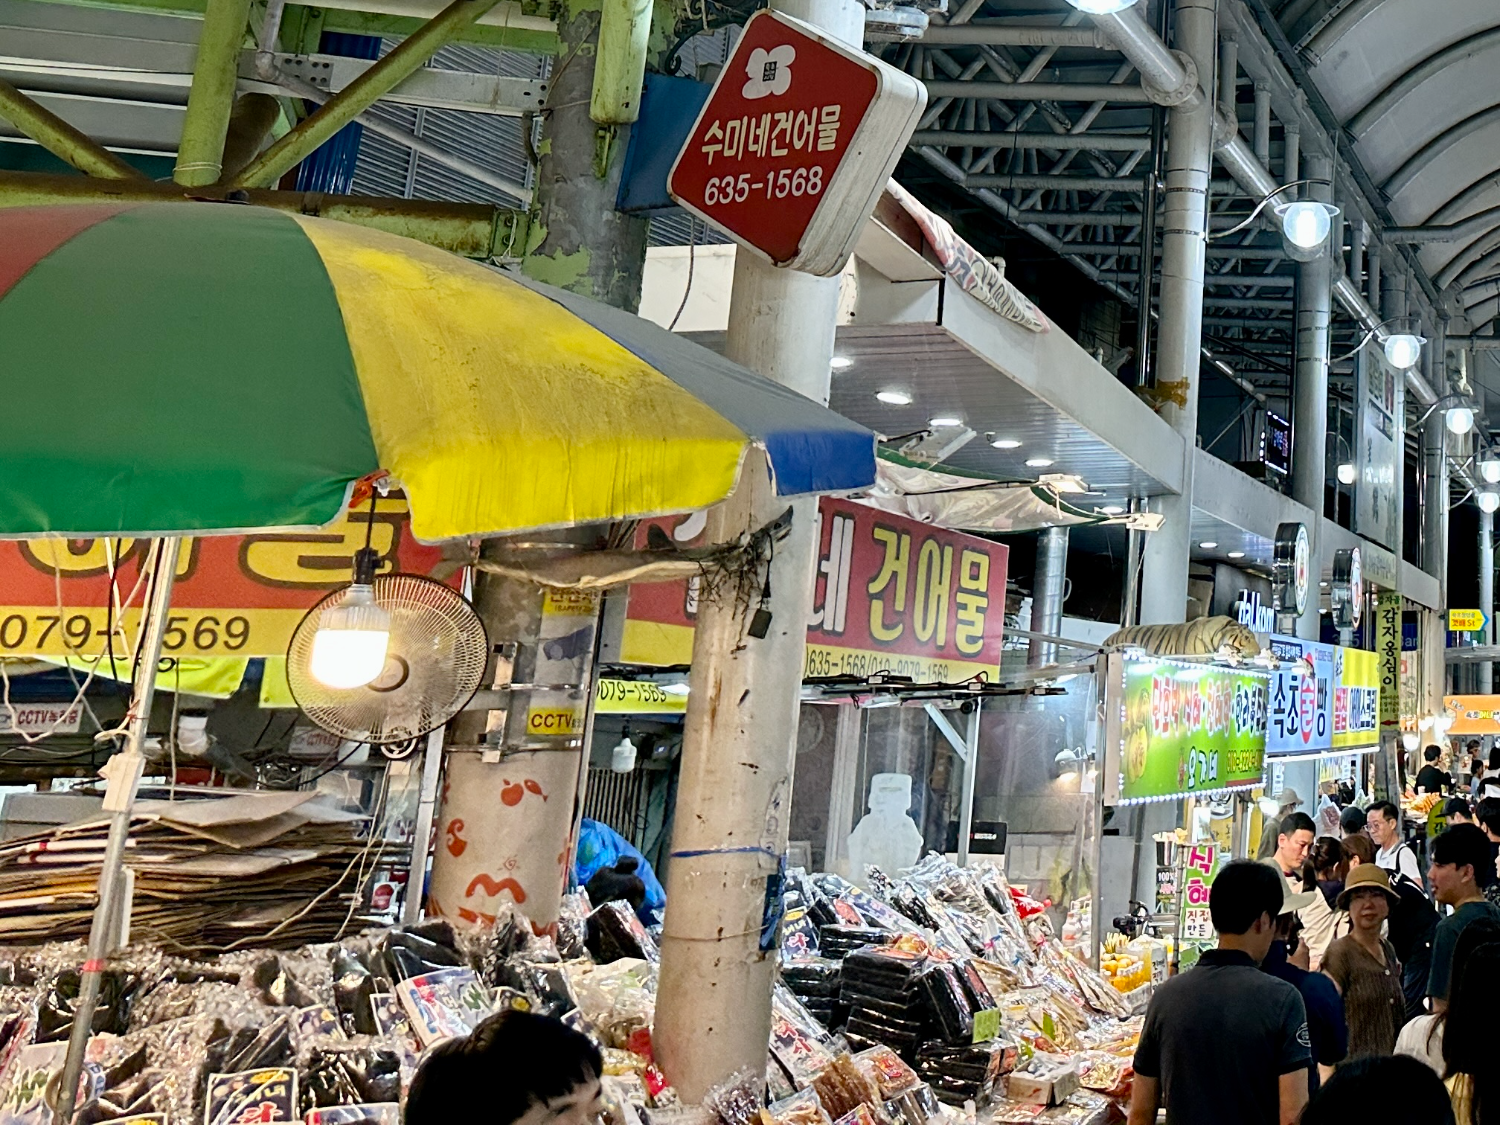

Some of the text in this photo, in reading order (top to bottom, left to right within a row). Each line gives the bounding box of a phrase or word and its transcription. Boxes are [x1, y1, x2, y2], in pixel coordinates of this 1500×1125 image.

[701, 104, 841, 165] 수미네건어물
[704, 166, 824, 206] 635-1568
[868, 526, 990, 654] 건어물
[0, 614, 251, 651] 079-569
[1382, 607, 1398, 691] 감자옹심이
[1273, 673, 1328, 739] 속초술빵
